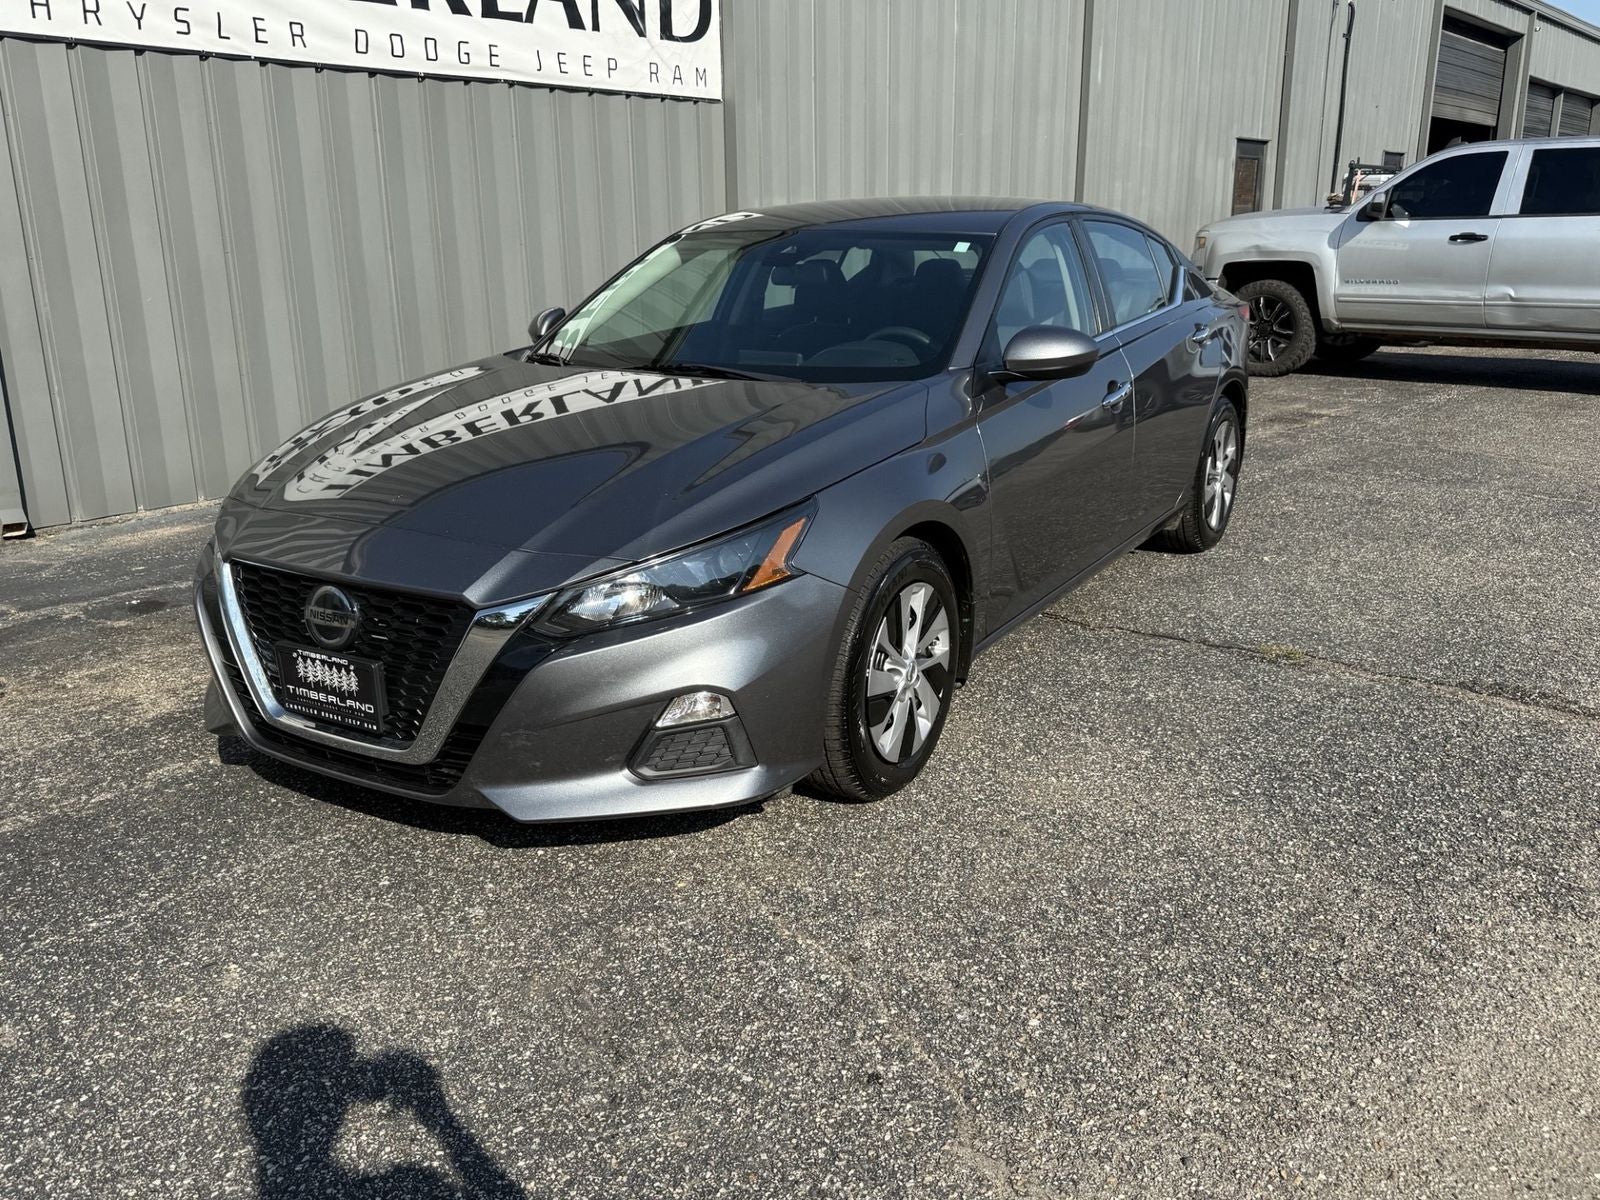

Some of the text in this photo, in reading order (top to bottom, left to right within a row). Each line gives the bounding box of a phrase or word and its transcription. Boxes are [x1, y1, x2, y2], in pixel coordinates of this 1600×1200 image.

[354, 28, 500, 68] DODGE
[536, 49, 618, 80] JEEP
[648, 61, 708, 88] RAM
[308, 608, 349, 626] NISSAN
[297, 649, 349, 666] TIMBERLAND
[286, 684, 375, 714] TIMBERLAND
